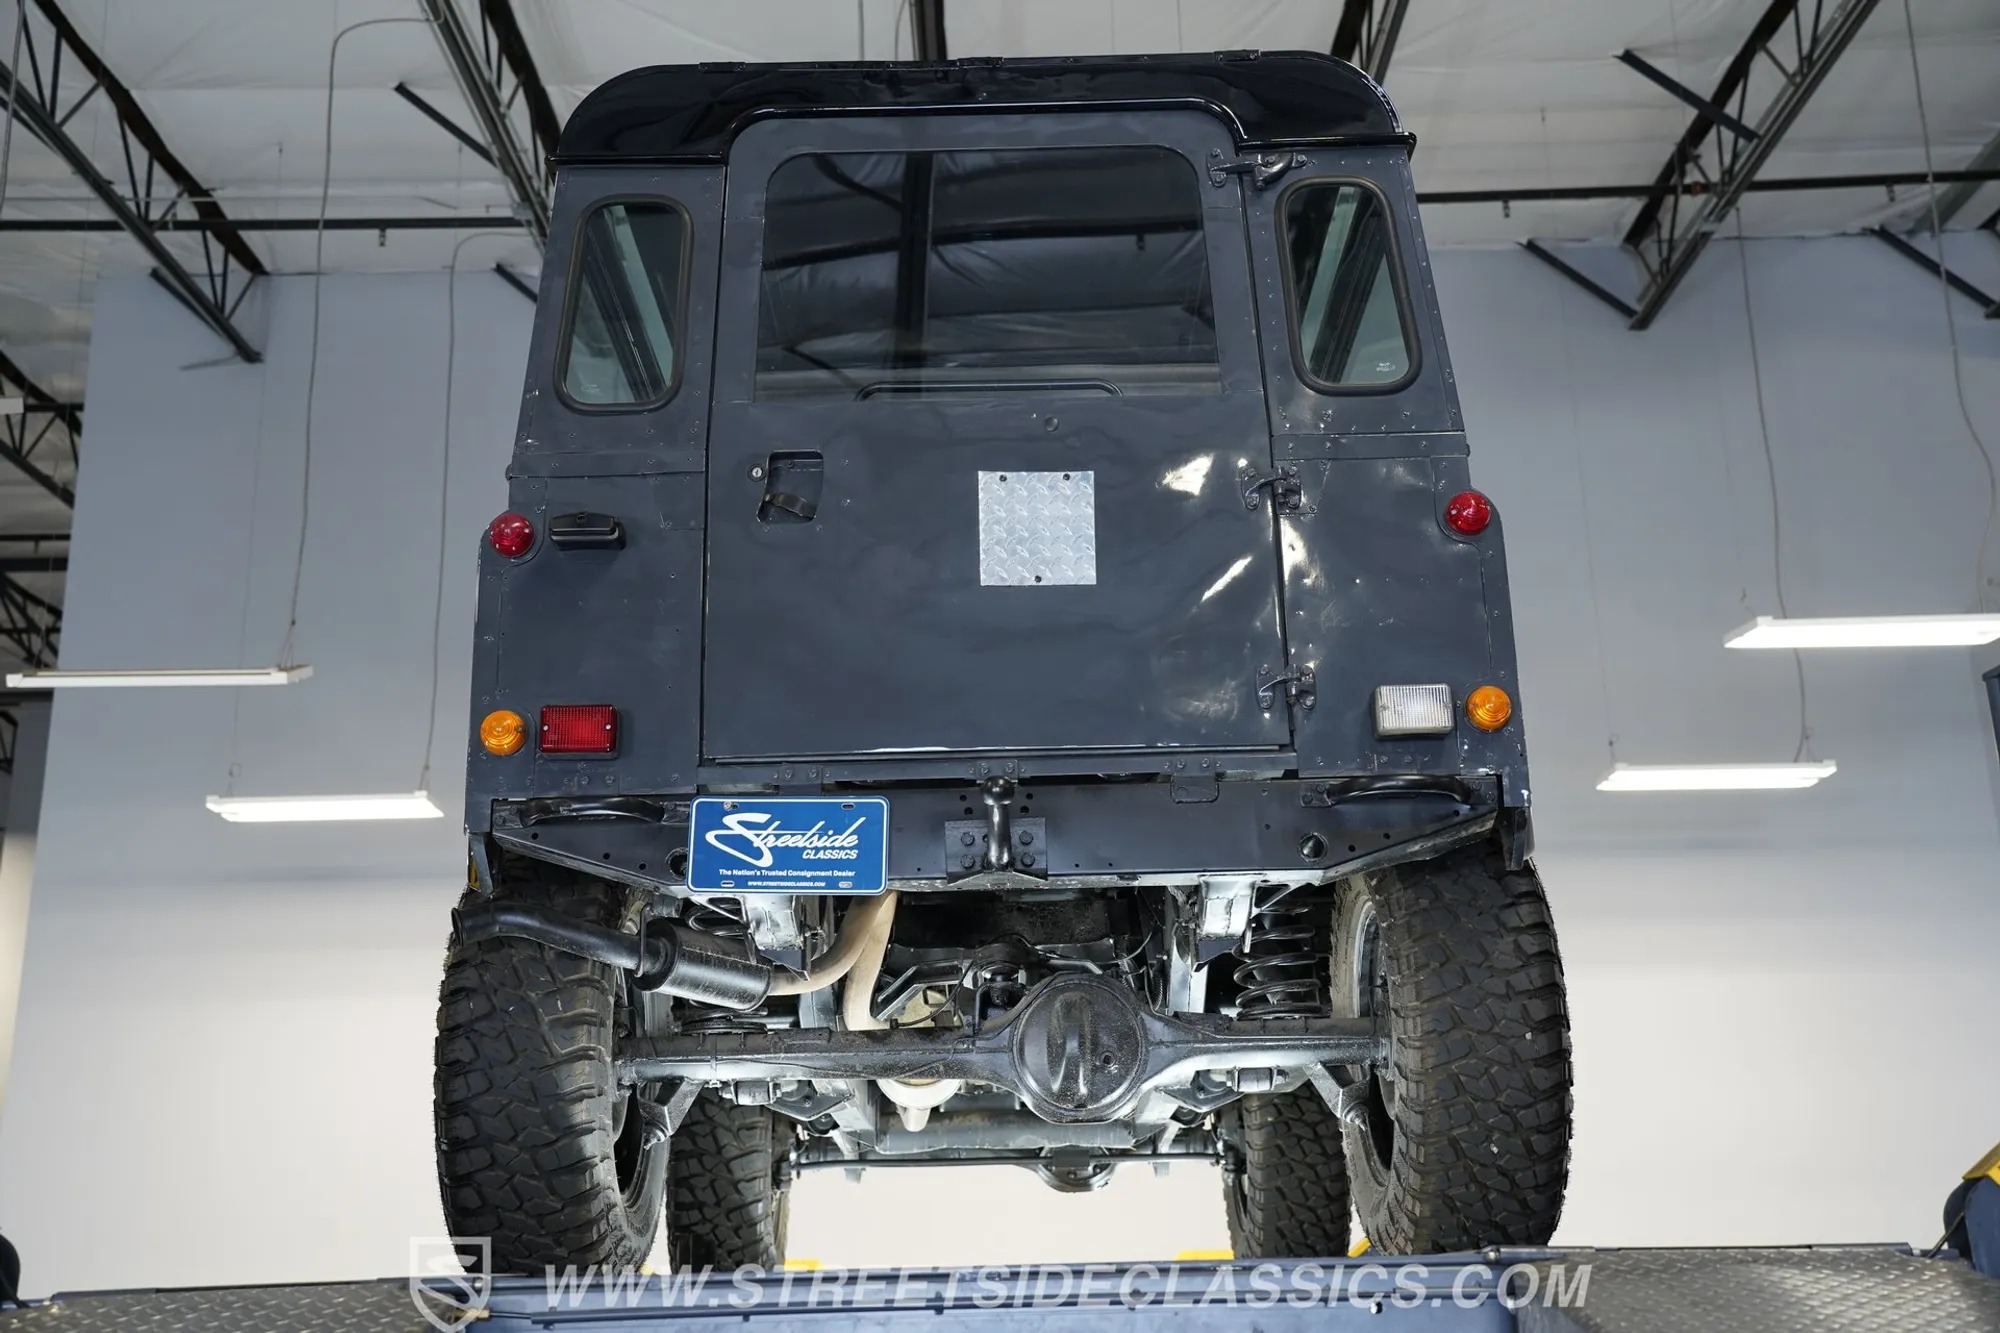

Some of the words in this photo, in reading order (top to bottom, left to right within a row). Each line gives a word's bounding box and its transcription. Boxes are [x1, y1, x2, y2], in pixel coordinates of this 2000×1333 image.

[705, 812, 867, 868] Streetside
[802, 849, 859, 860] CLASSICS
[761, 869, 787, 877] Trusted
[788, 869, 832, 878] Consignment
[833, 869, 856, 877] Dealer
